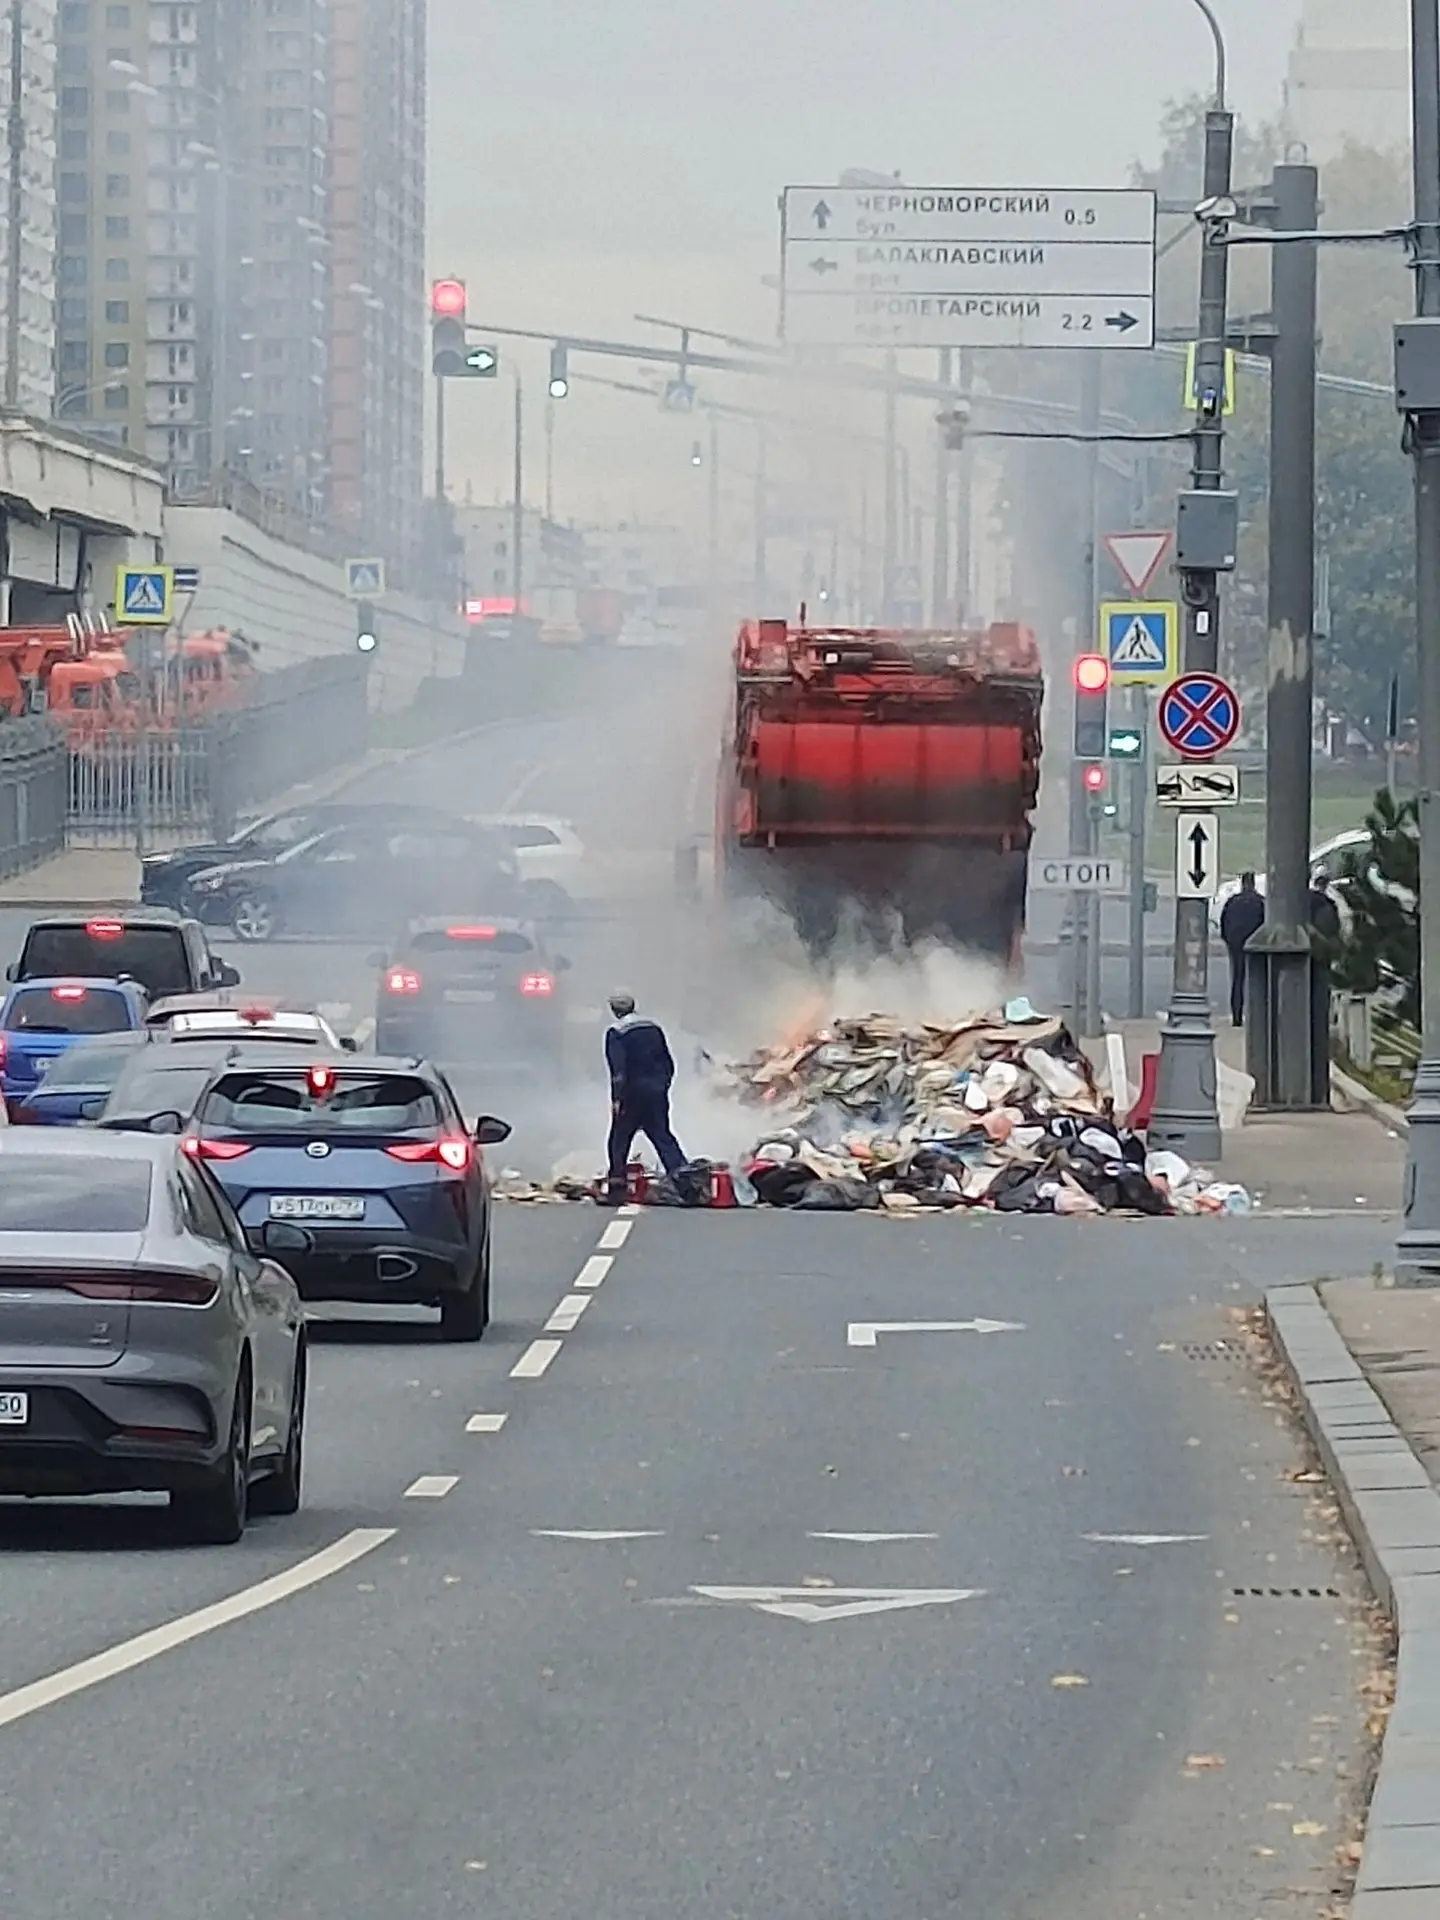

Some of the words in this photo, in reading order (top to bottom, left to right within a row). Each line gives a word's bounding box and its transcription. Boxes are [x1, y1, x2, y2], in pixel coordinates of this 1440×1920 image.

[855, 193, 1051, 214] ЧЕРНОМОРСКИЙ
[1065, 209, 1096, 225] 0.5
[855, 244, 1046, 265] БАЛАКЛАВСКИЙ
[1062, 314, 1092, 330] 2.2
[1044, 863, 1110, 883] СТОП
